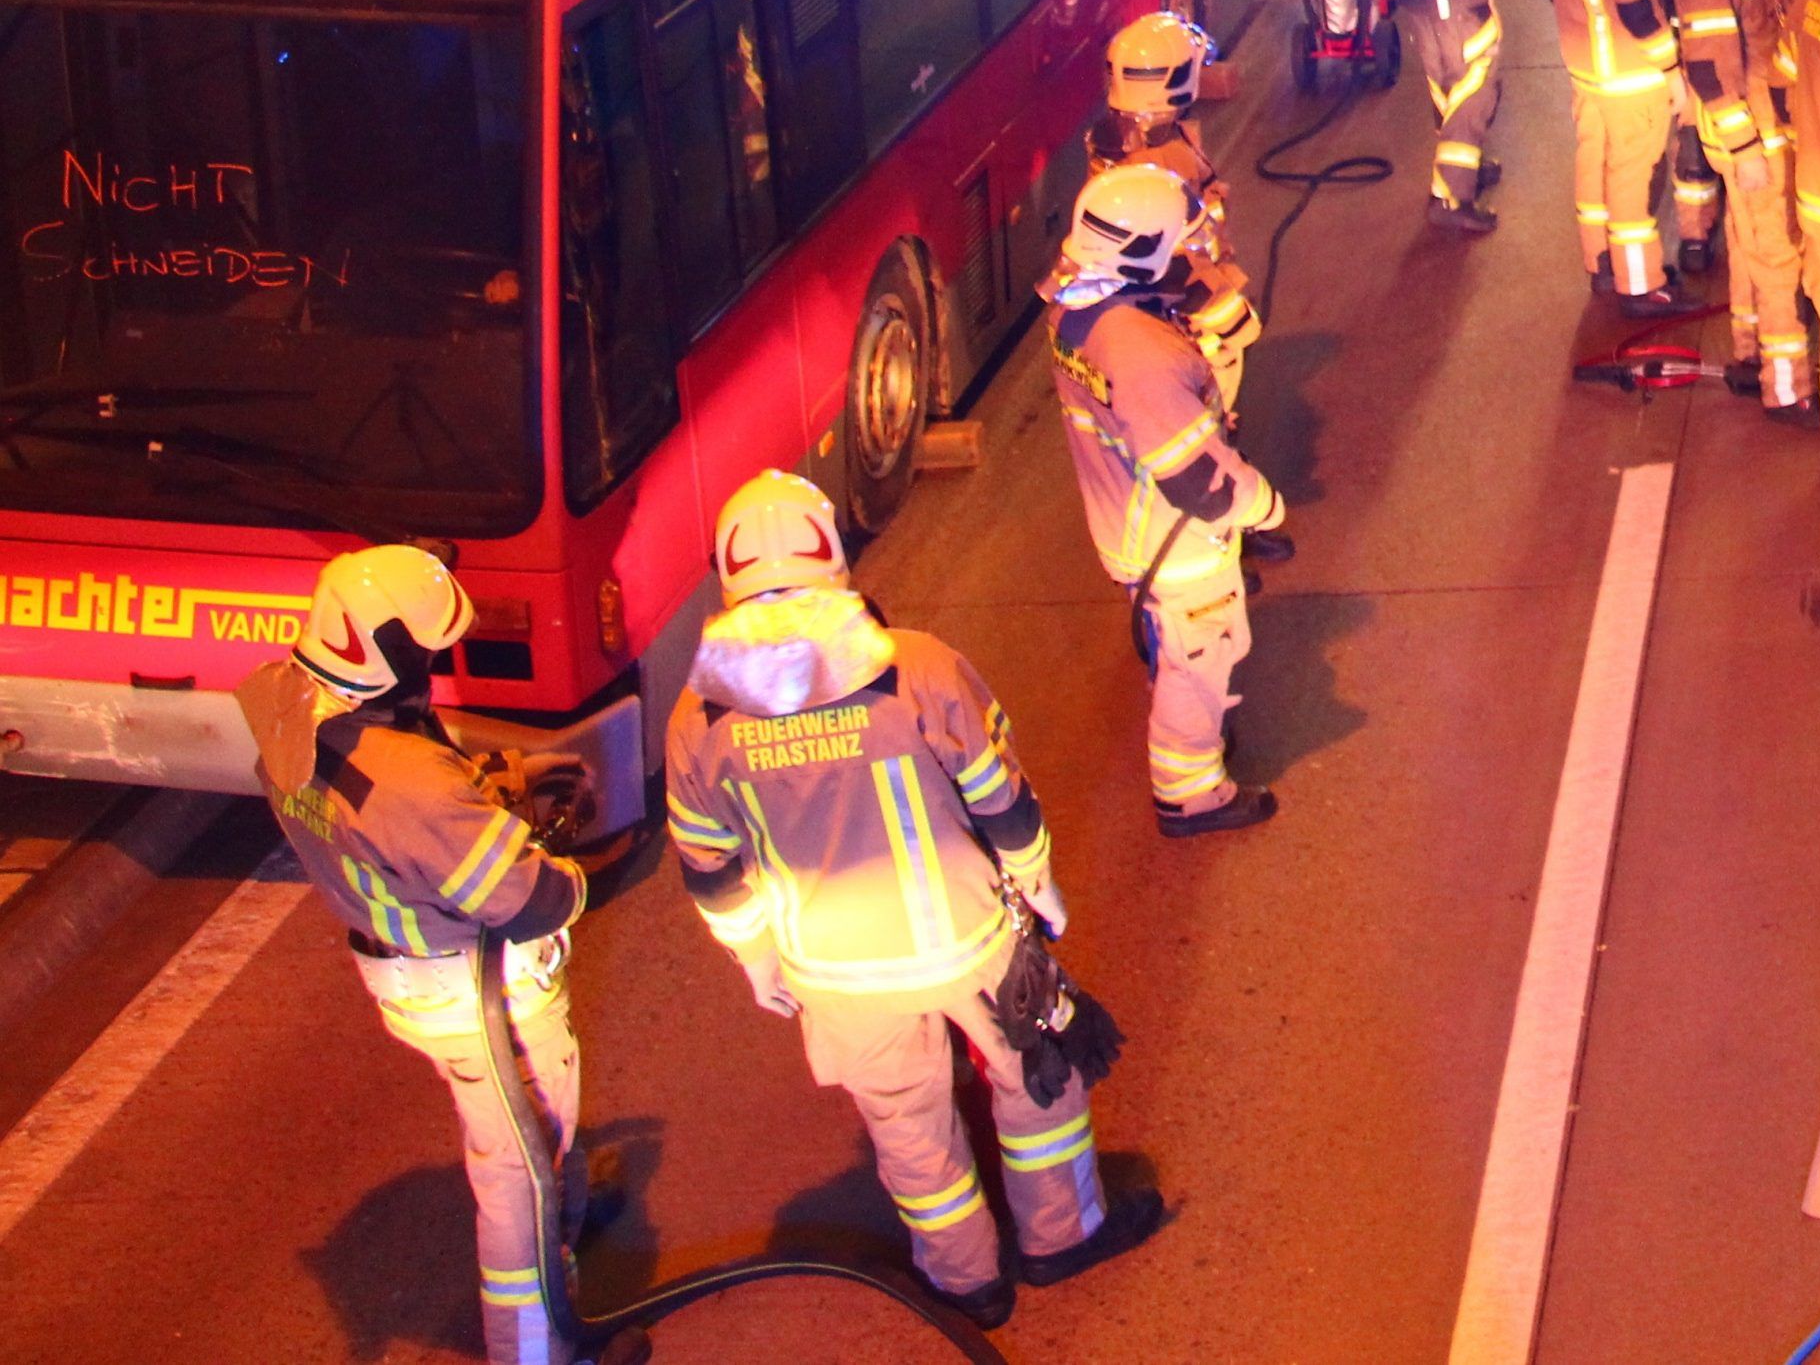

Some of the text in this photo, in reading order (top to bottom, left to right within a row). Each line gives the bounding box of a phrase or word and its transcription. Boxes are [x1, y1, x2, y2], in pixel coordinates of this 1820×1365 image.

[0, 571, 312, 646] achter VAND
[730, 703, 871, 748] FEUERWEHR
[745, 732, 865, 773] FRASTANZ
